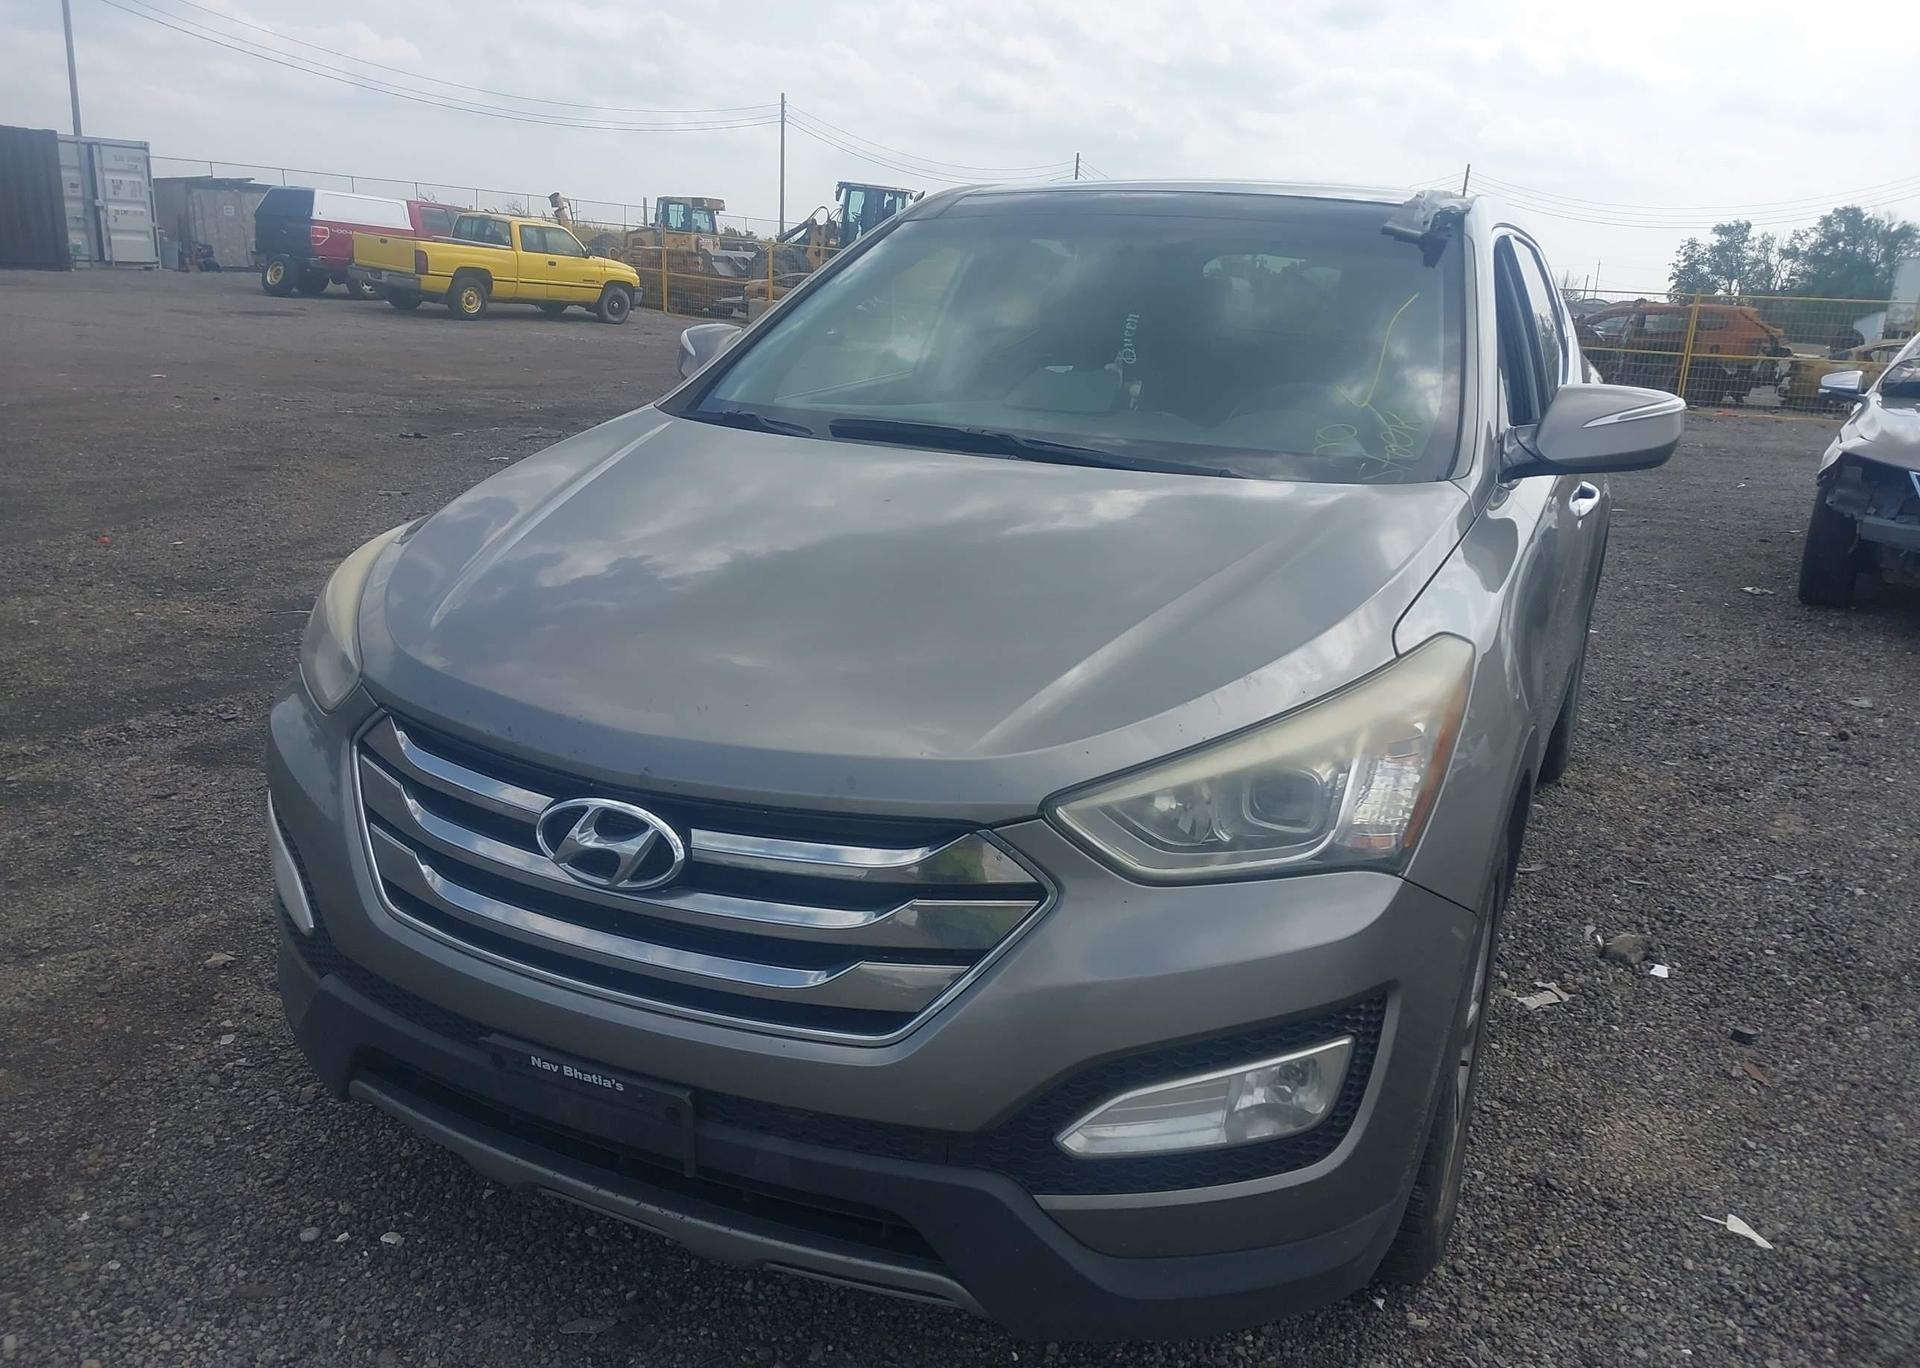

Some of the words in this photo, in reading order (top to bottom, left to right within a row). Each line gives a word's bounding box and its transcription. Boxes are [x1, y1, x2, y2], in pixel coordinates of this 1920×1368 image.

[1122, 313, 1140, 364] Queen
[531, 1055, 559, 1073] Nav
[563, 1065, 624, 1091] Bhatia's
